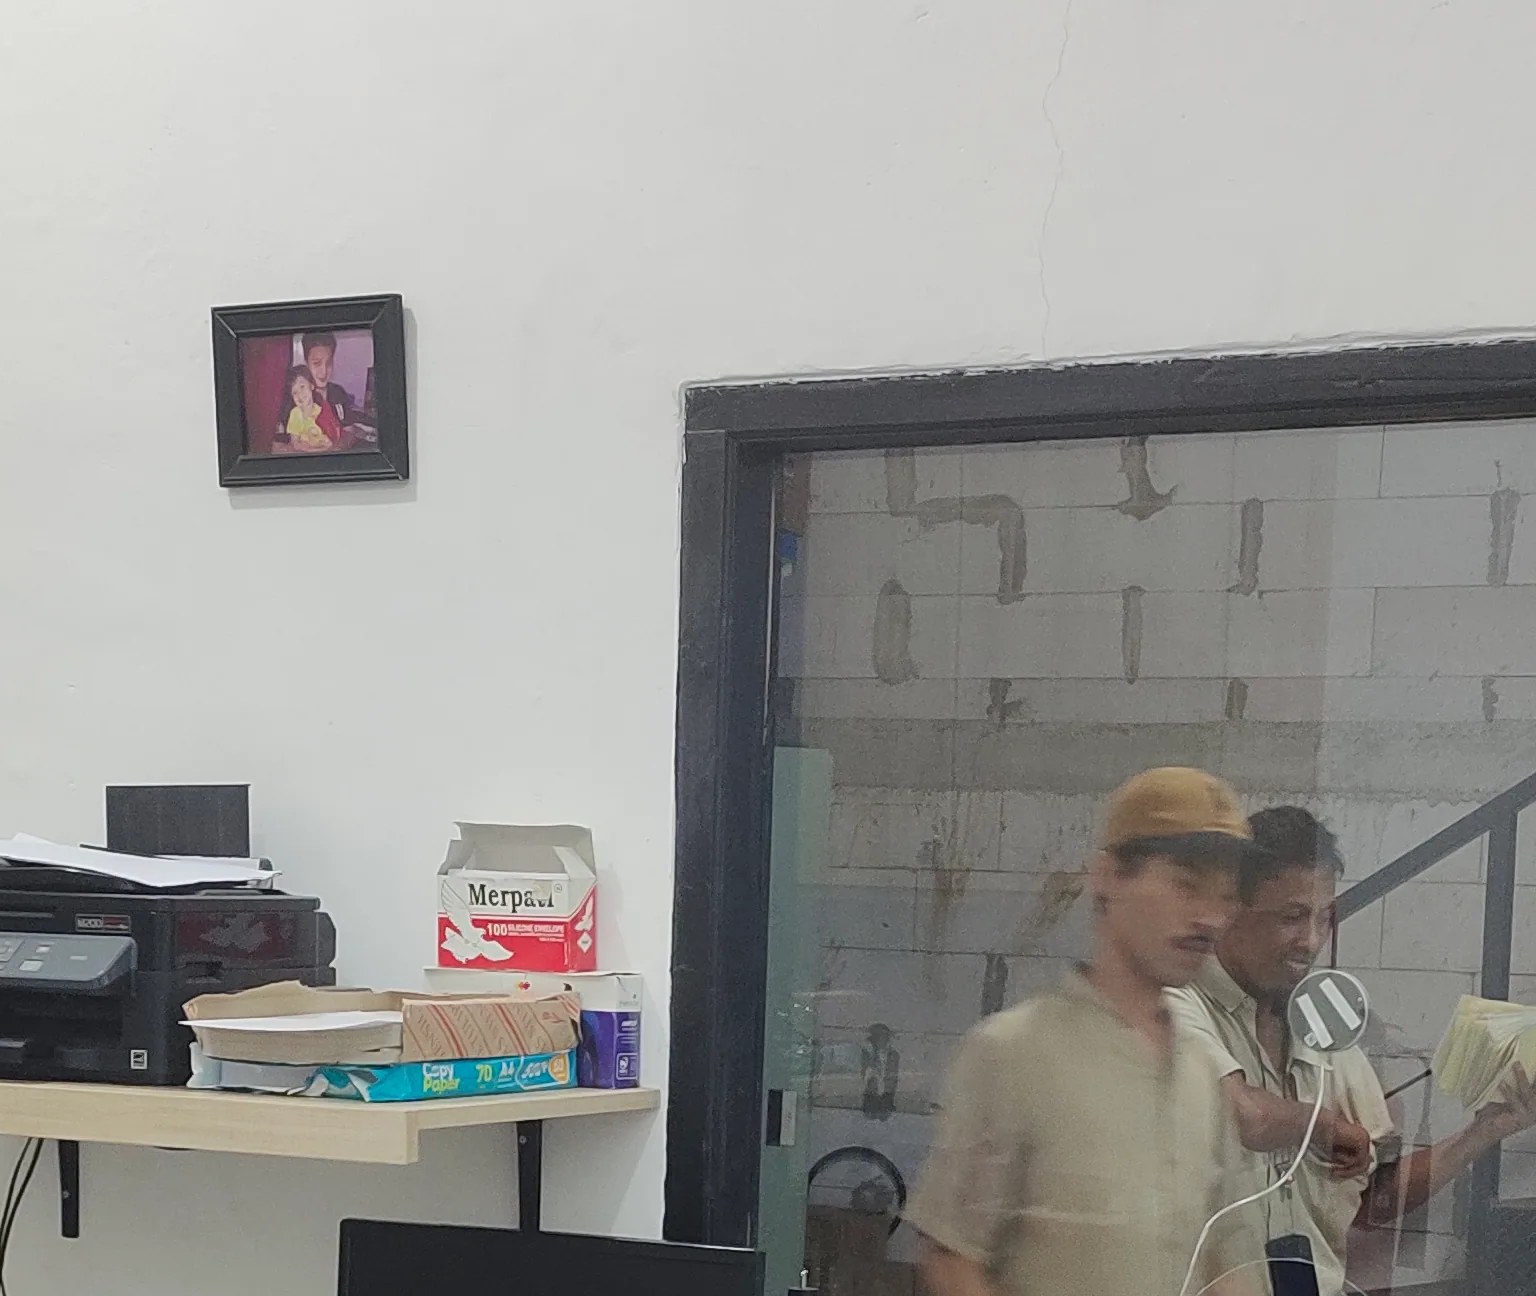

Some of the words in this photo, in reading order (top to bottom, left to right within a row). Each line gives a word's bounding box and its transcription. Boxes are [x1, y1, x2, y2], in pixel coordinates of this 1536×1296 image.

[487, 922, 508, 937] 100
[422, 1062, 454, 1081] Copy
[422, 1077, 461, 1095] Paper
